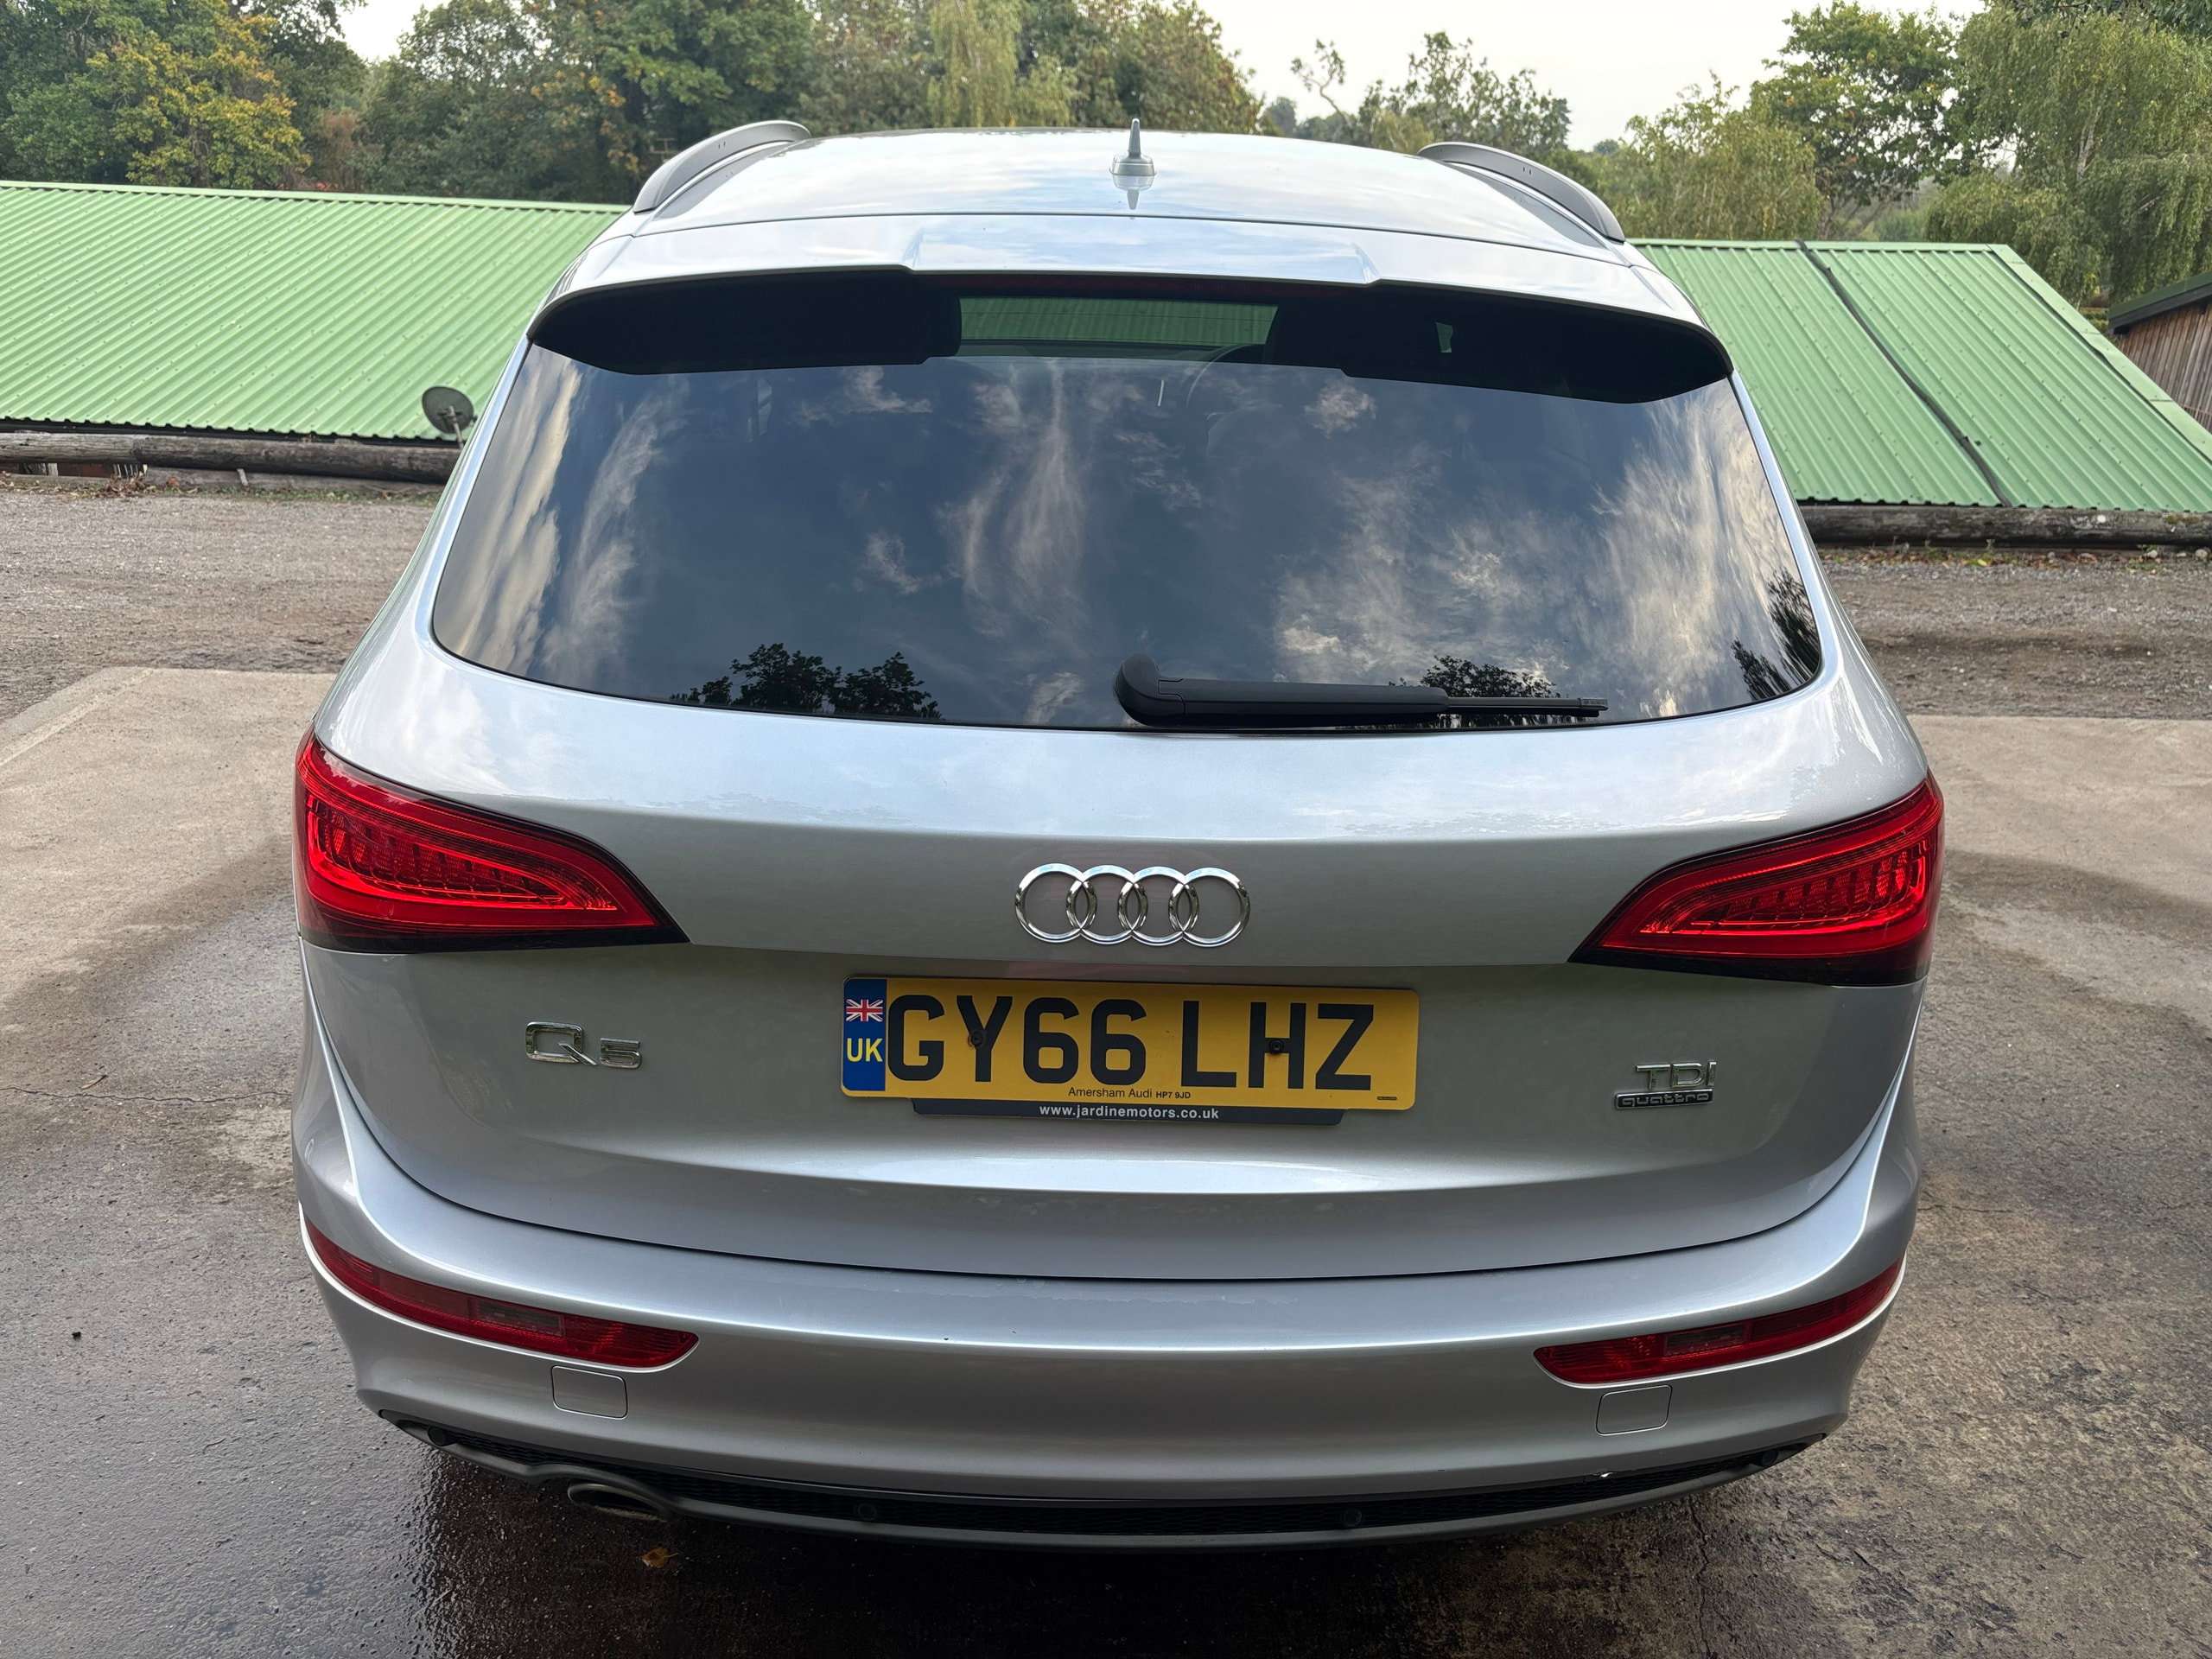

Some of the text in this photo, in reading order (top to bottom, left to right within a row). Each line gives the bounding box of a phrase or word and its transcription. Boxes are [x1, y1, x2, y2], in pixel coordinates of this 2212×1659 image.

[525, 1021, 642, 1070] Q5
[846, 1037, 883, 1063] UK
[887, 994, 1375, 1091] GY66 LHZ
[1636, 1061, 1717, 1090] TDI
[1068, 1086, 1125, 1098] Amersham
[1128, 1088, 1153, 1099] Audi
[1621, 1092, 1710, 1108] quattro
[1039, 1104, 1219, 1120] www.jardinemotors.co.uk
